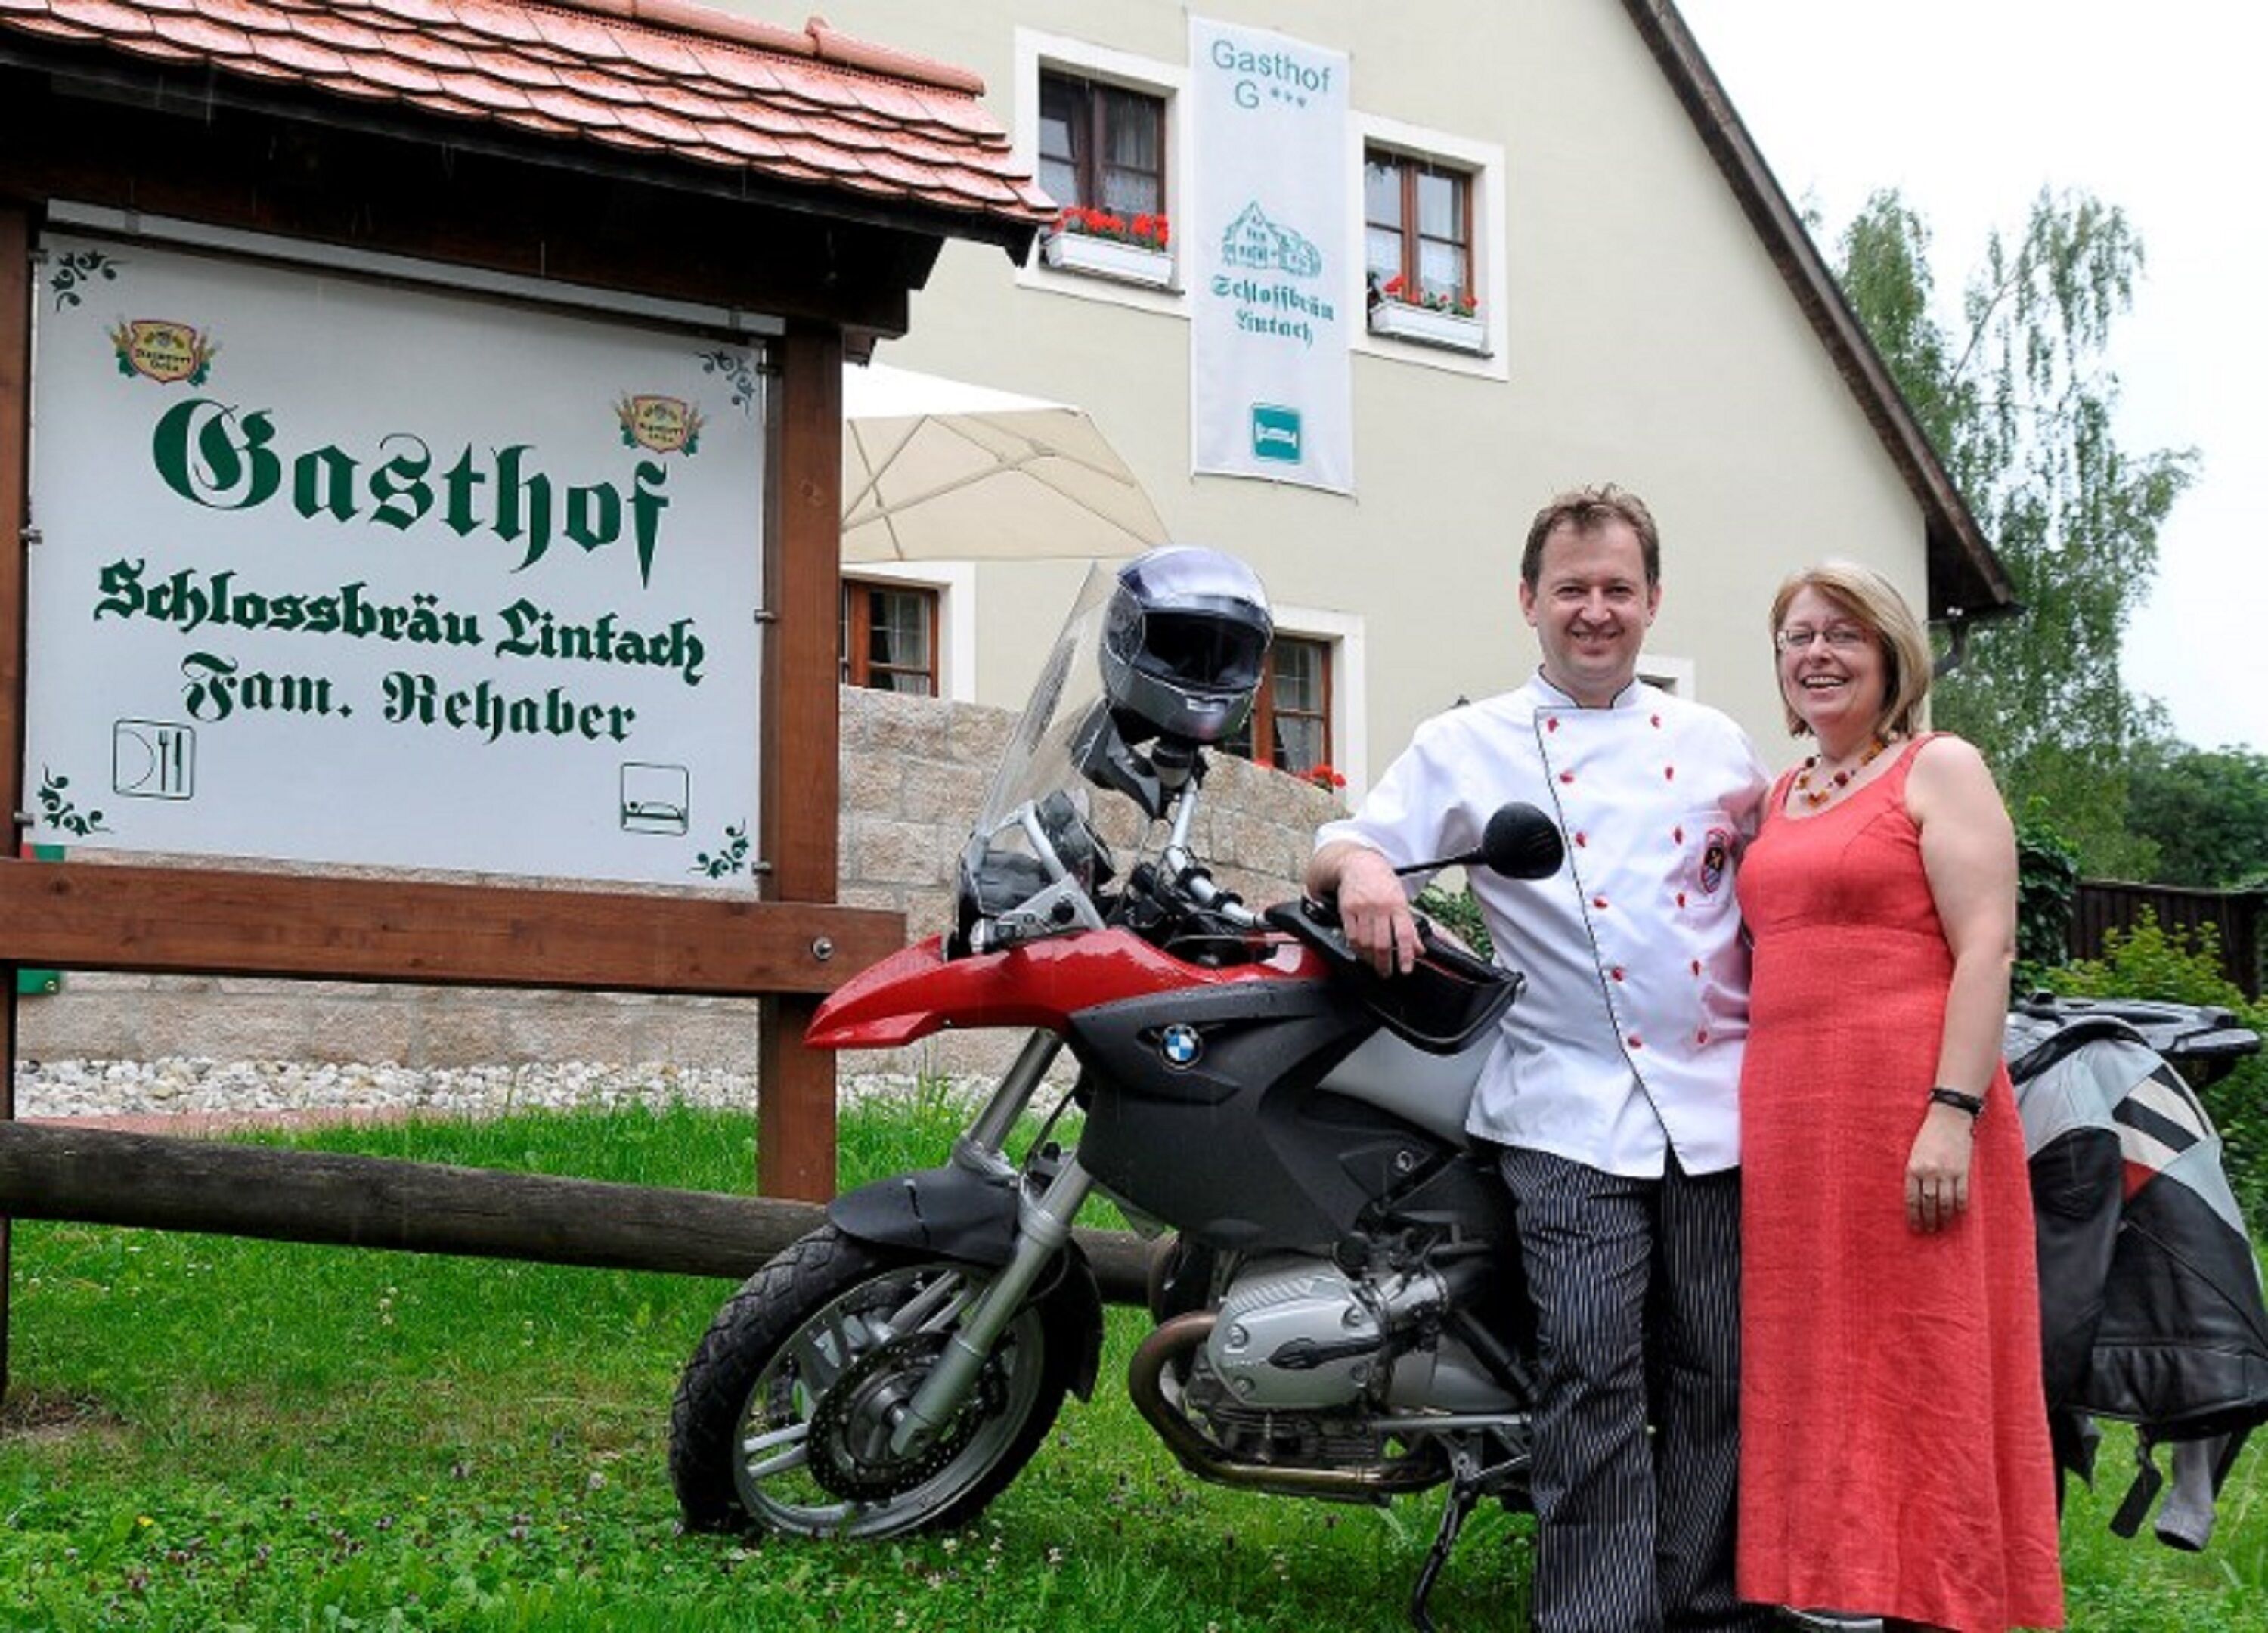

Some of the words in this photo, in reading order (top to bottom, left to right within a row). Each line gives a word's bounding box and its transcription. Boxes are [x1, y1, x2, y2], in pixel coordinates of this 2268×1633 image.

[1212, 39, 1331, 91] Gasthof
[153, 397, 670, 590] Gasthof
[93, 559, 484, 646] Schlossbräu
[181, 652, 353, 722] Fam.
[382, 671, 637, 745] Rehaber
